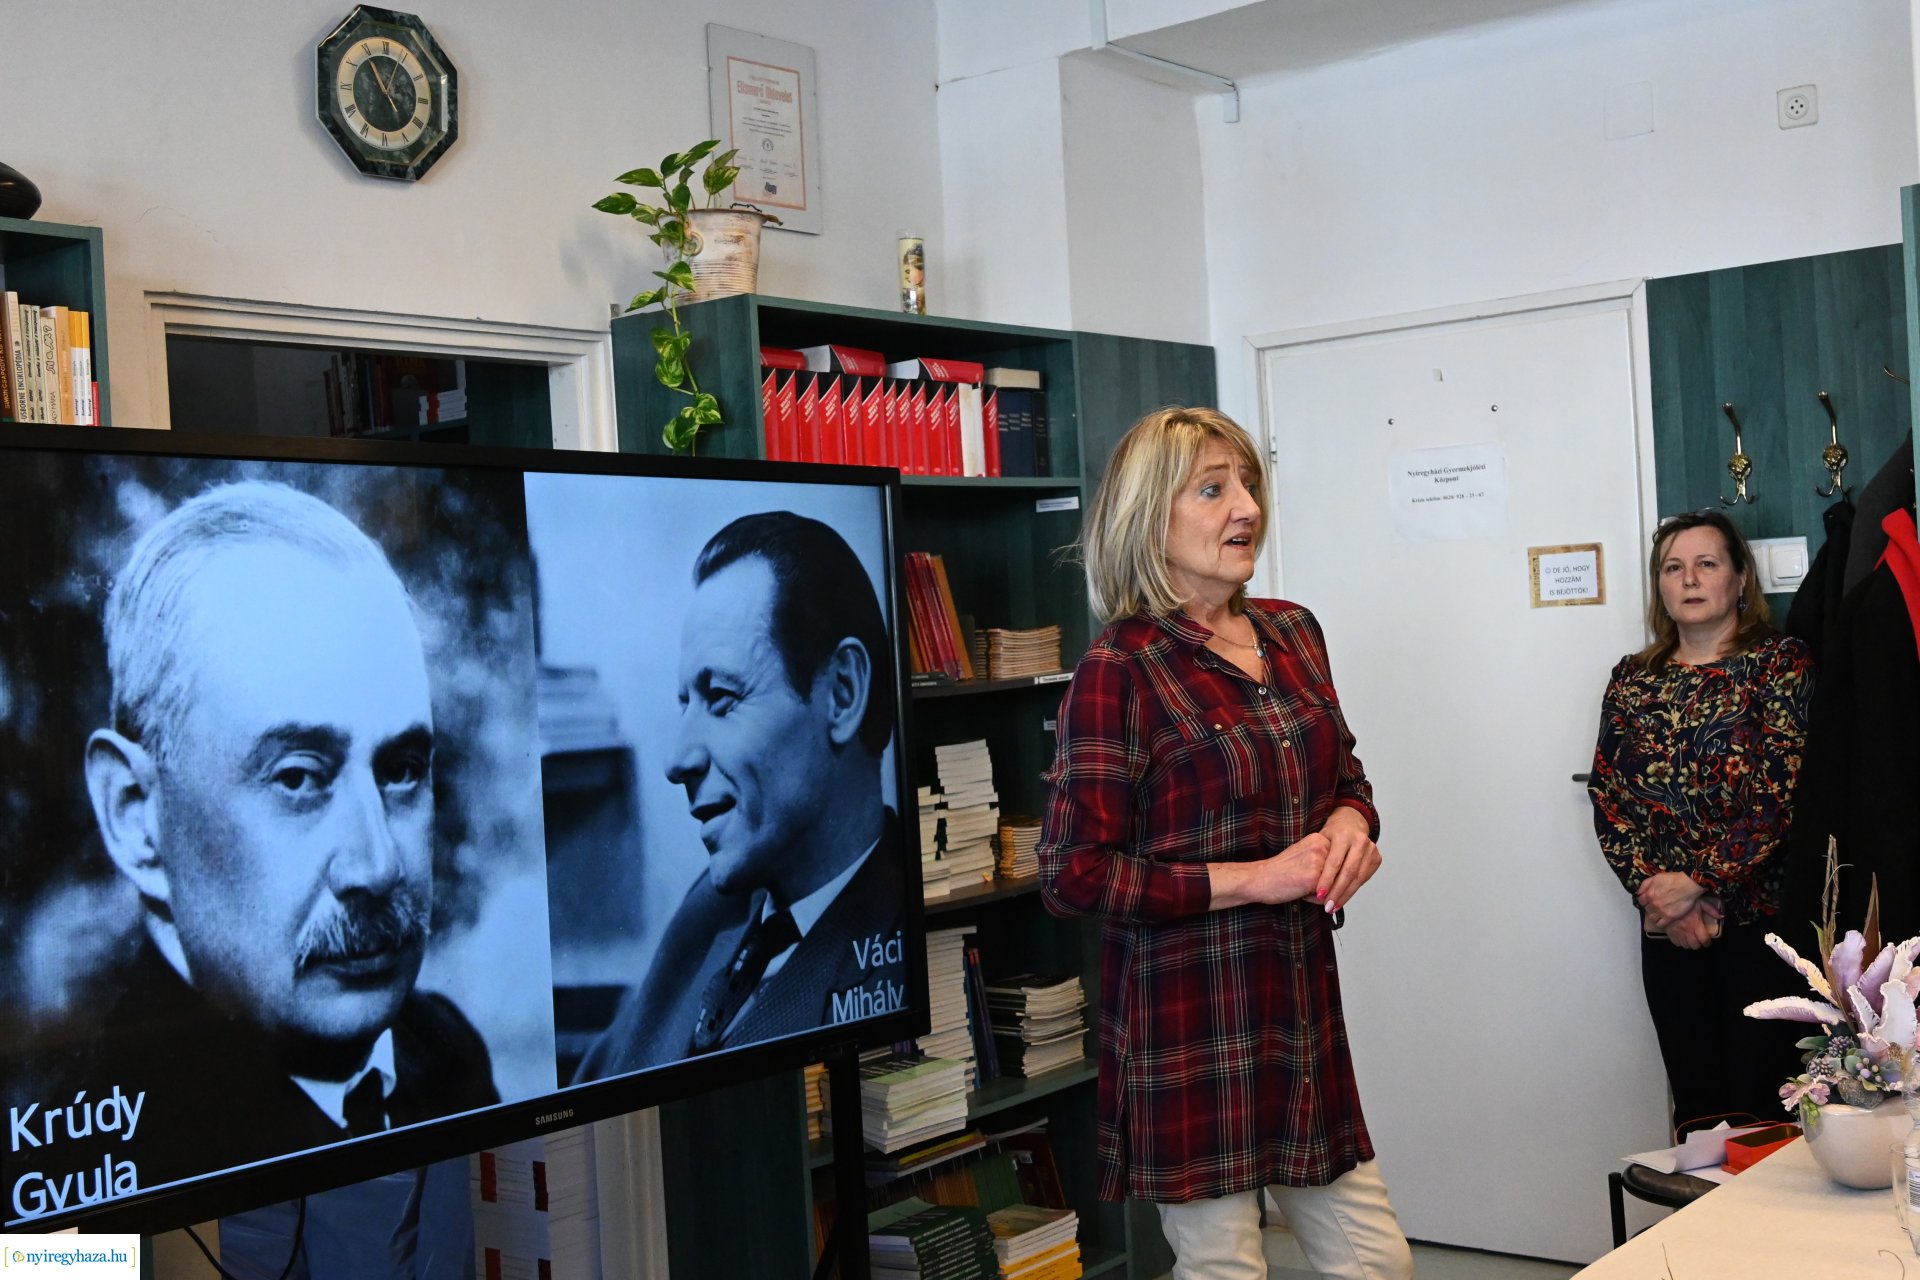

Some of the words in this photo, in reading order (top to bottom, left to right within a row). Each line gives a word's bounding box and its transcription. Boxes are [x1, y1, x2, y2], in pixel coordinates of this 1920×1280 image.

[1555, 576, 1582, 584] HOZZÁM
[852, 930, 903, 970] Váci
[10, 1085, 146, 1152] Krúdy
[535, 1108, 574, 1126] SAMSUNG
